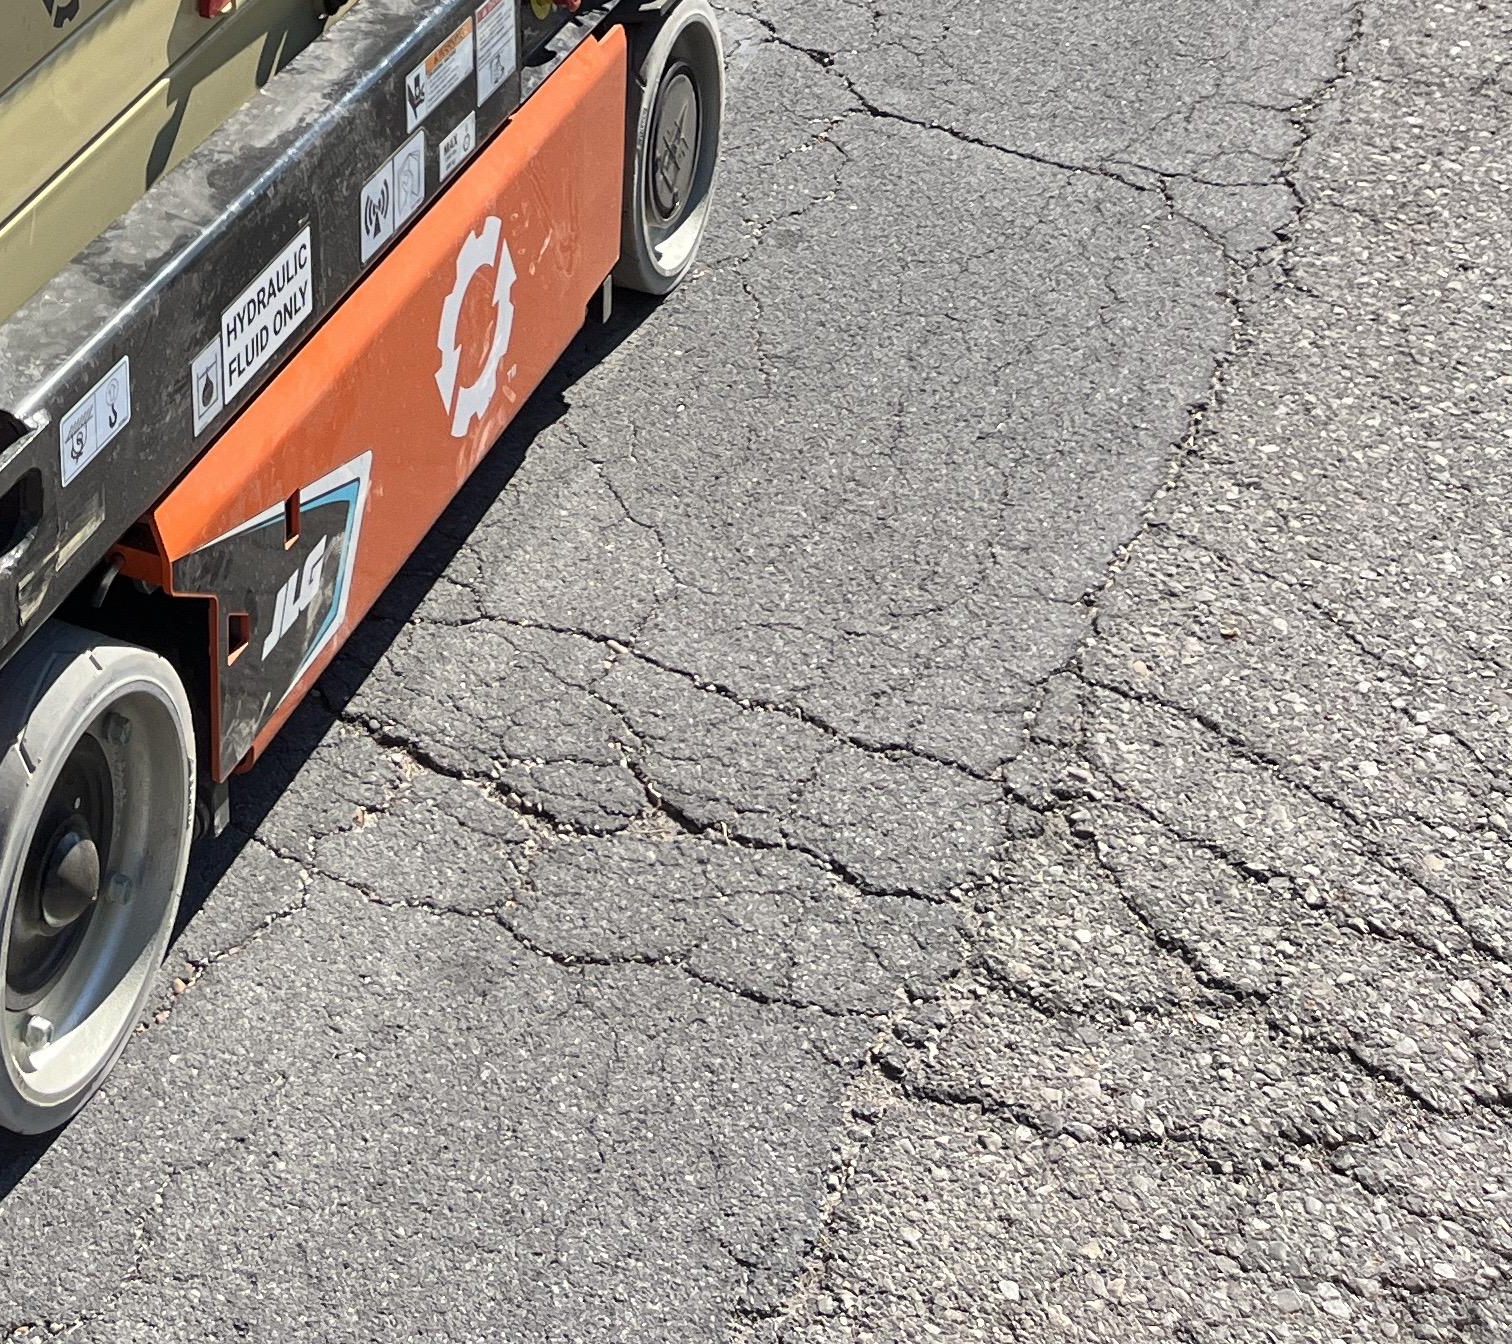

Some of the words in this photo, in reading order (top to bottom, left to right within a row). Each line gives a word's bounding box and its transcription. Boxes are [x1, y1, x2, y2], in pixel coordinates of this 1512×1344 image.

[226, 243, 308, 347] HYDRAULIC
[229, 325, 269, 387] FLUID
[273, 280, 308, 336] ONLY
[261, 534, 328, 662] JLG
